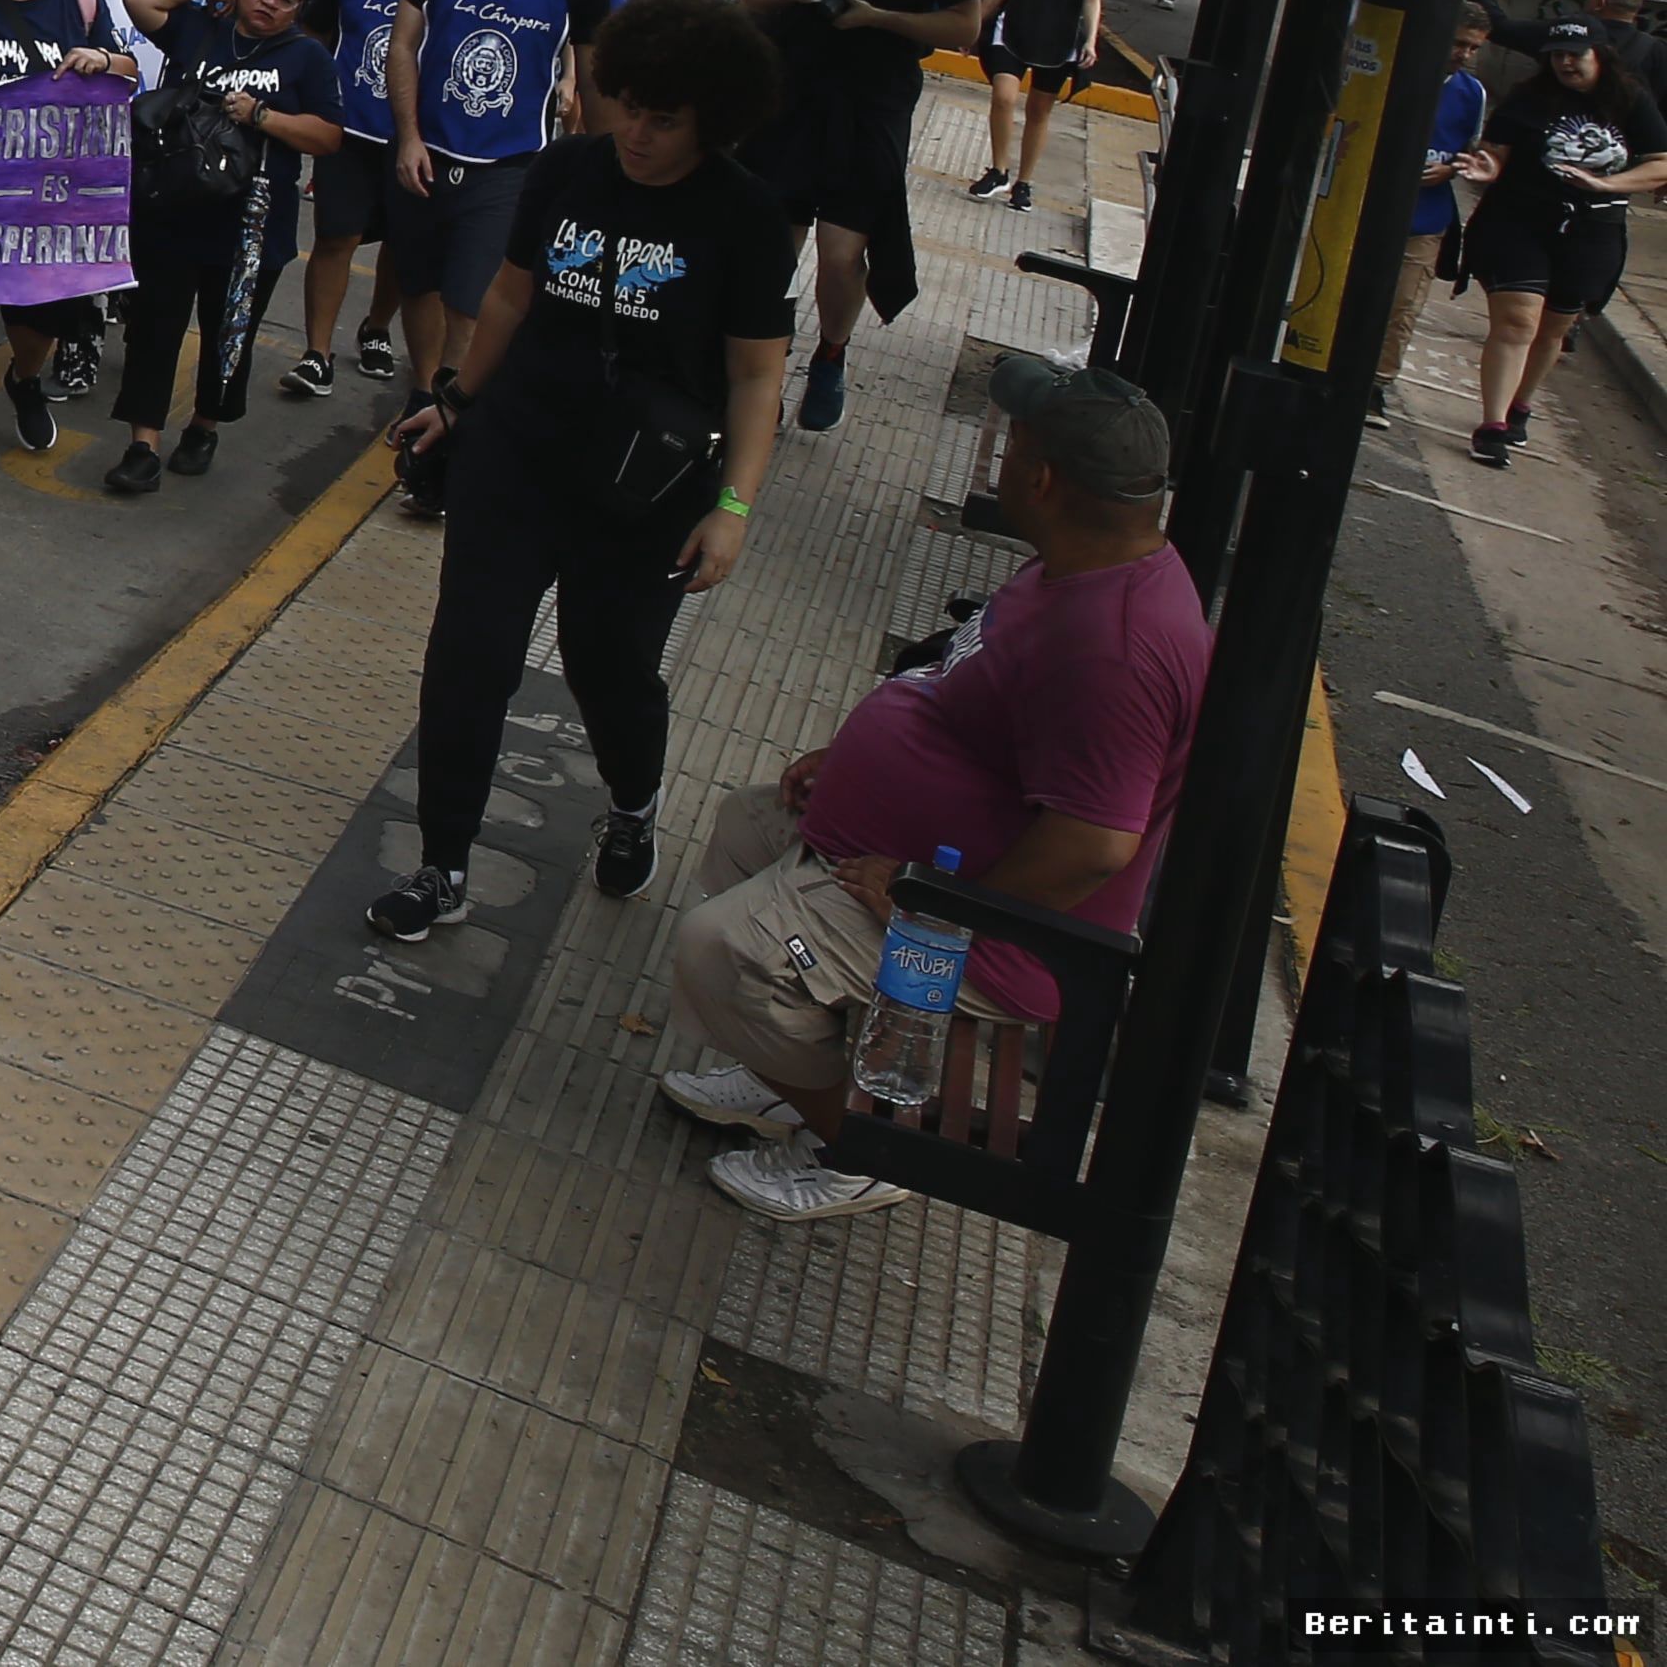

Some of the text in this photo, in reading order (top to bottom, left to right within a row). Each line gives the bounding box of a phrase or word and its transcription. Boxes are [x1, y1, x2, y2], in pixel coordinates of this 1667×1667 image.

[478, 2, 551, 34] Cámpora
[40, 175, 70, 203] ES
[553, 218, 675, 276] LA CPORA
[544, 280, 660, 321] ALMAGRO BOEDO
[634, 289, 647, 305] 5
[890, 944, 957, 980] ARUBA
